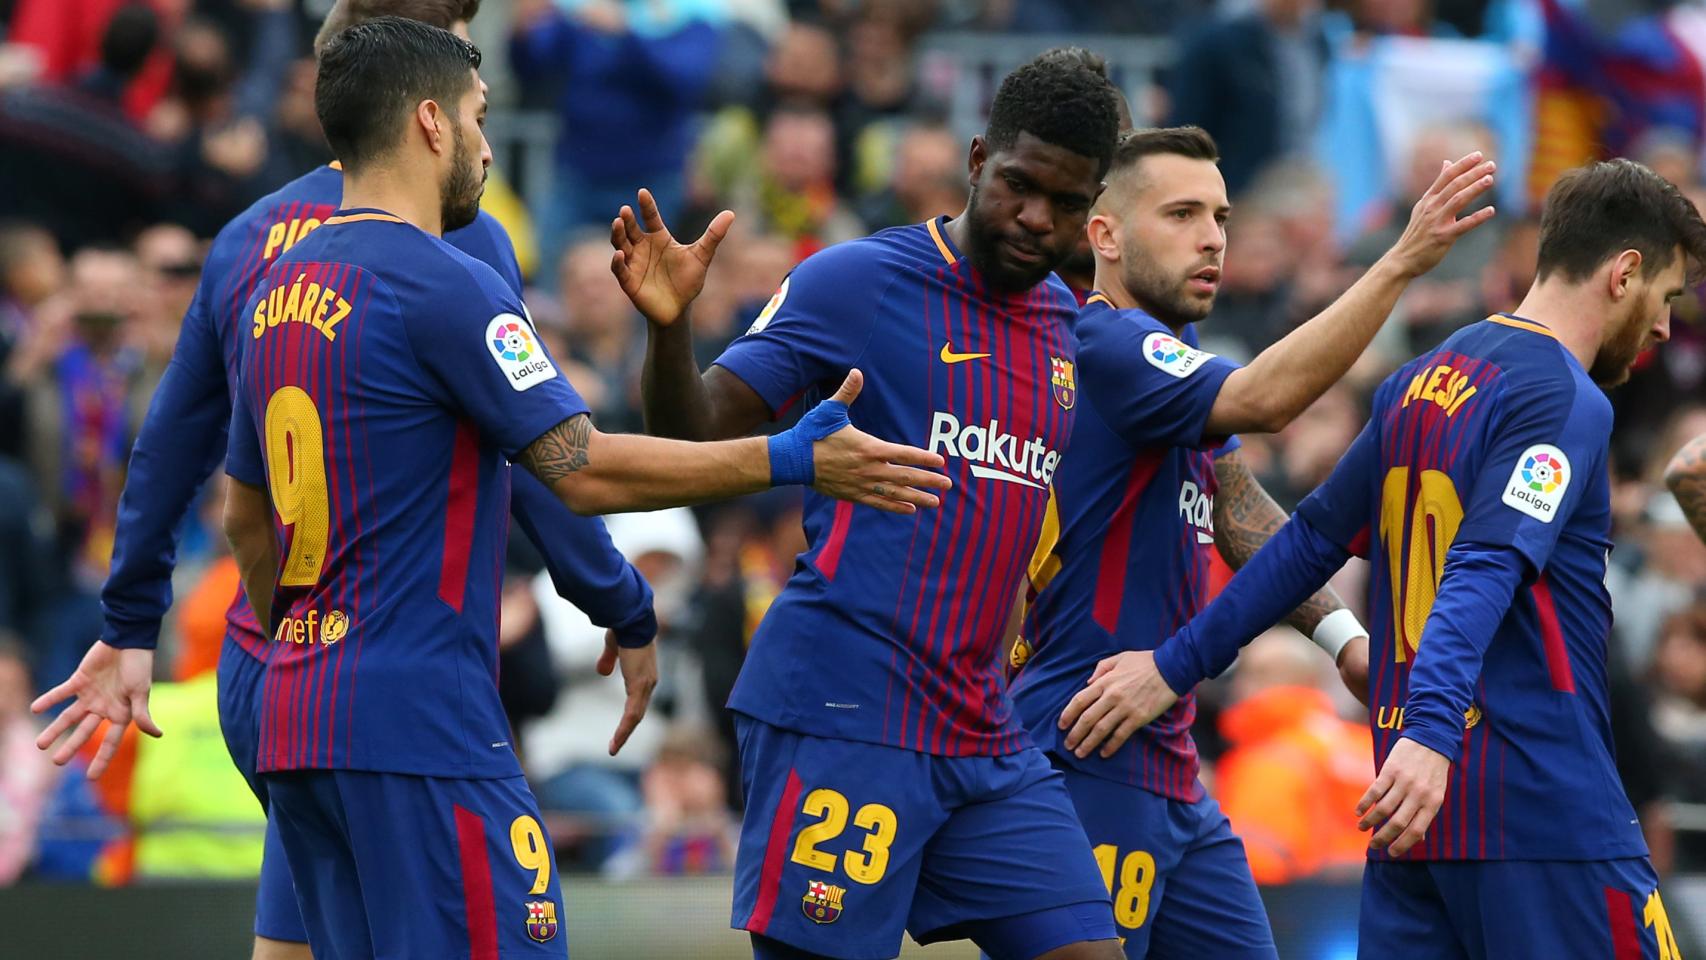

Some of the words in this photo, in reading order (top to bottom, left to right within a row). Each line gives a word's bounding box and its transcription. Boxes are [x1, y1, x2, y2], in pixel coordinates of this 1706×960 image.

[253, 273, 352, 342] SUÁREZ
[512, 360, 549, 380] LaLiga
[1402, 365, 1477, 417] MESSI
[265, 386, 329, 586] 9
[1510, 486, 1551, 512] LaLiga
[1379, 466, 1465, 663] 10
[510, 815, 550, 895] 9
[790, 788, 898, 885] 23
